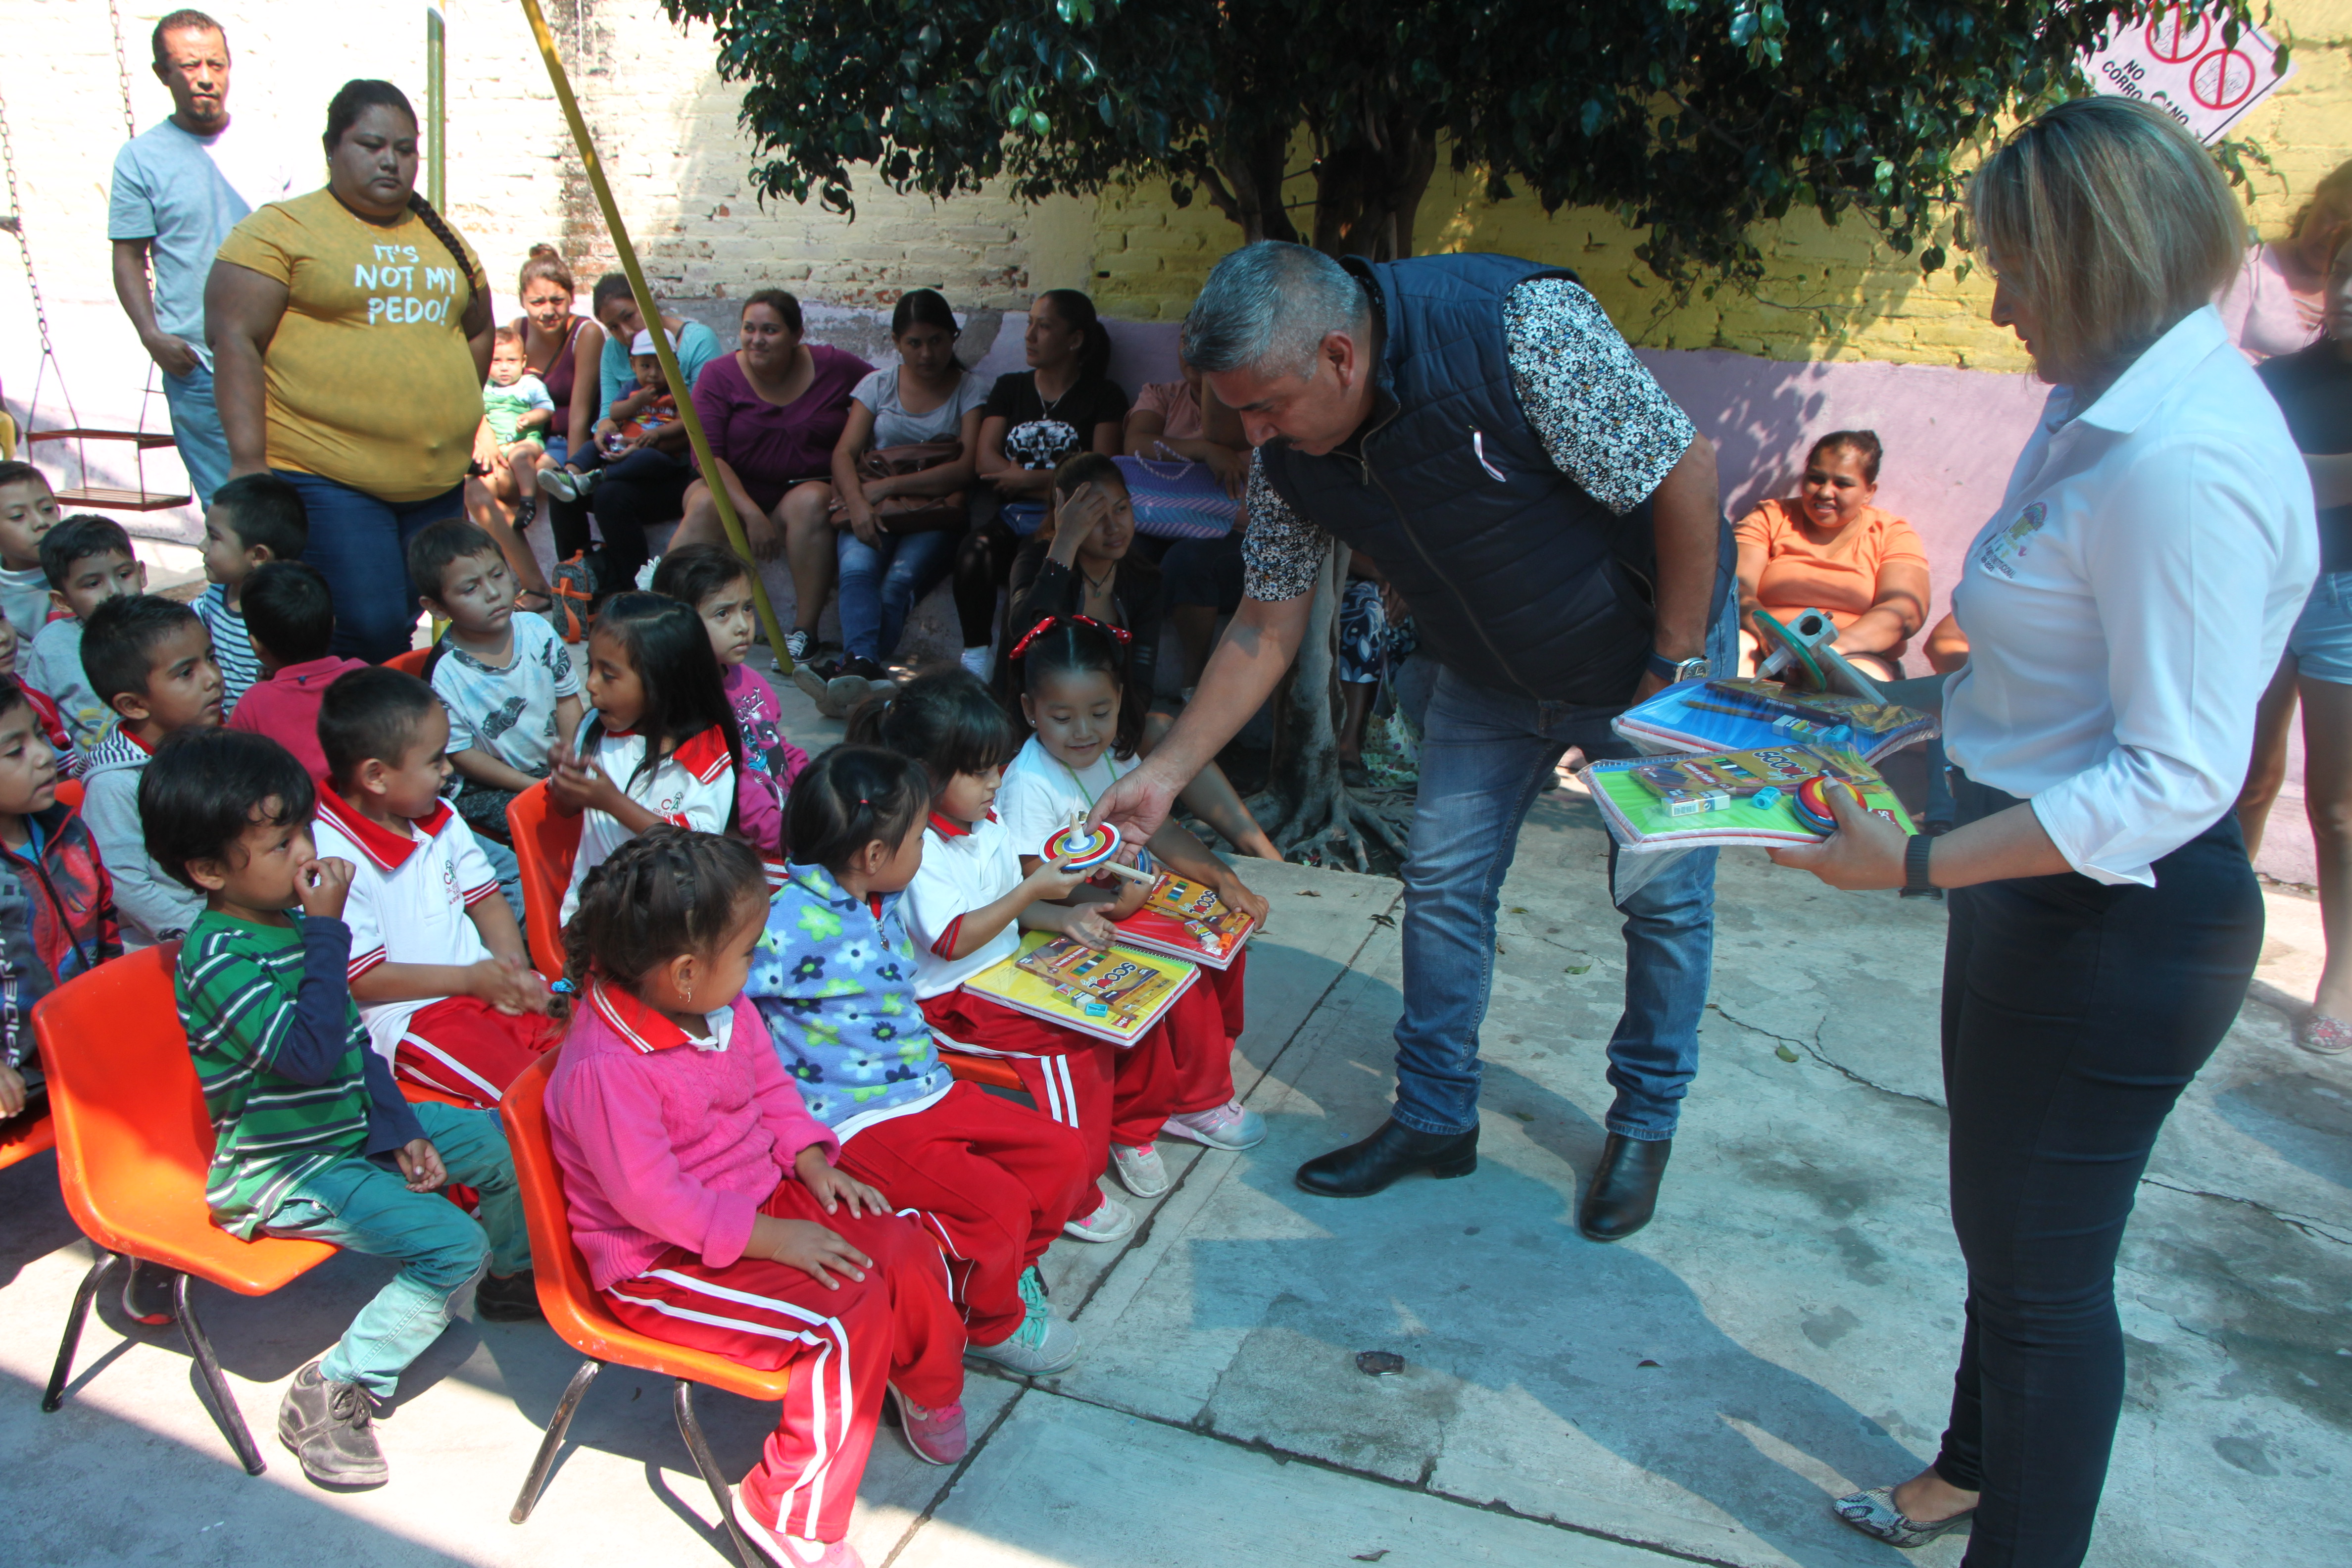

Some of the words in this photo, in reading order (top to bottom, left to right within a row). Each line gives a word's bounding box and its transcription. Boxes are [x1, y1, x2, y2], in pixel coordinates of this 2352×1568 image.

[2102, 60, 2143, 99] CORRO
[2123, 59, 2145, 81] NO
[373, 244, 420, 263] IT'S
[354, 264, 415, 292] NOT
[426, 266, 456, 294] MY
[368, 295, 451, 326] PEDO!
[0, 939, 20, 1069] SPIDER-
